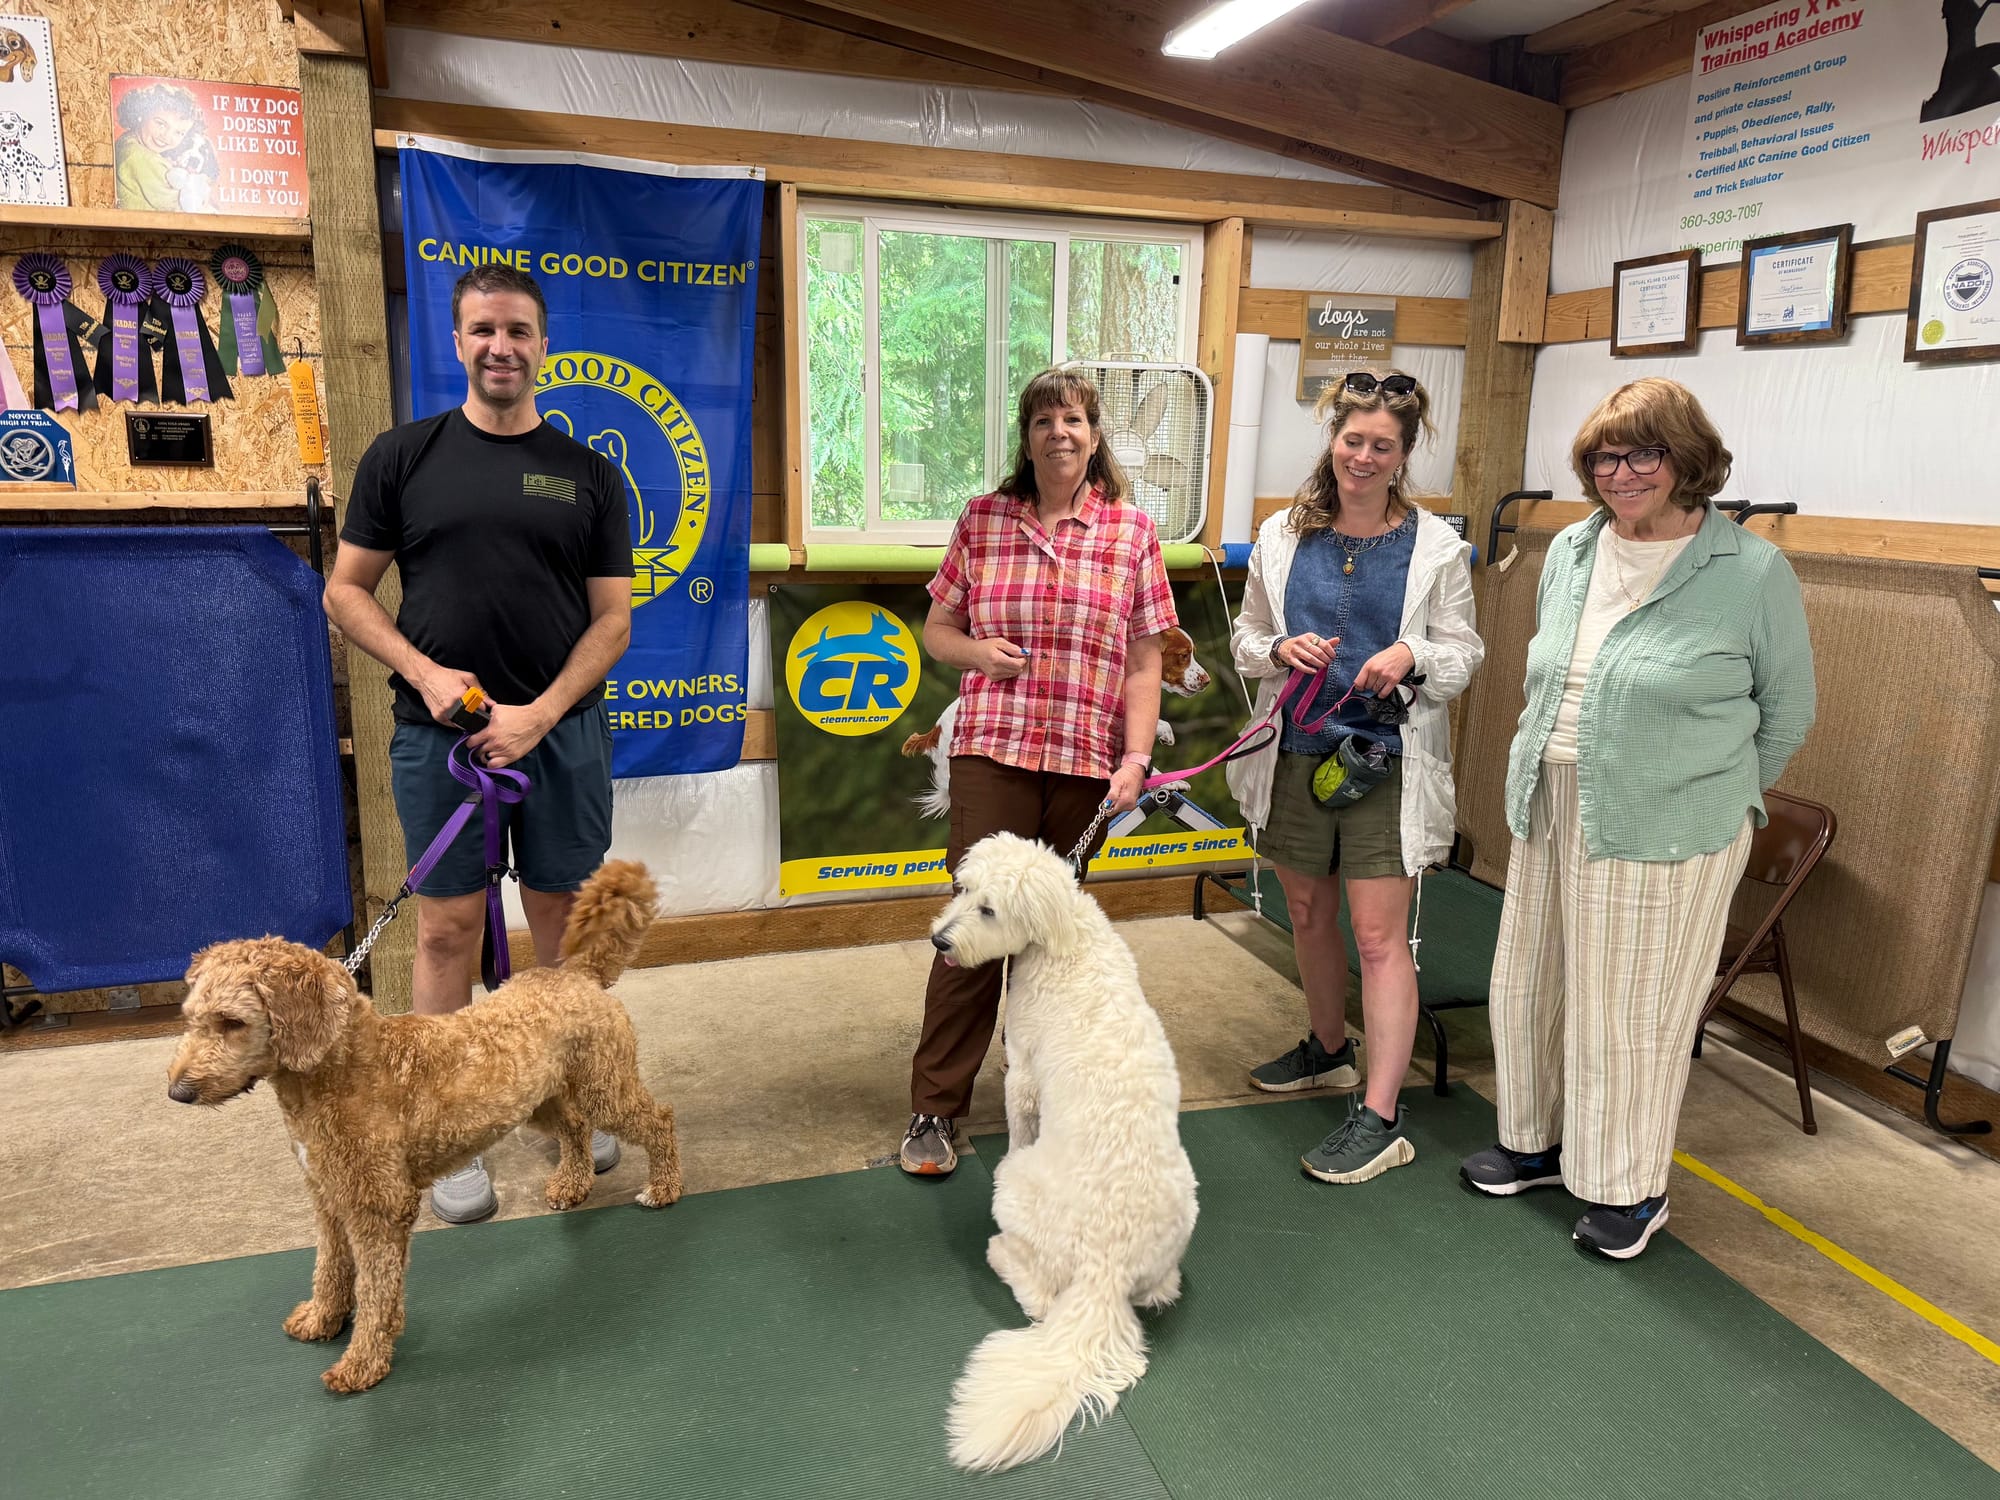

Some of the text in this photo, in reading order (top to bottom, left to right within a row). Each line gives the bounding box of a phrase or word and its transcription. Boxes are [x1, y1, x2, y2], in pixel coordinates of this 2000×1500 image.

[1700, 8, 1864, 73] Training Academy
[1704, 7, 1800, 51] Whispering
[1697, 55, 1848, 104] Positive Reinforcement Group
[212, 95, 299, 116] IF MY DOG
[1694, 90, 1792, 124] and private classes!
[222, 115, 292, 135] DOESN'T
[1703, 100, 1835, 141] Puppies, Obedience, Rally,
[217, 135, 301, 158] LIKE YOU,
[1699, 121, 1835, 161] Treibball, Behavioral Issues
[1695, 132, 1871, 179] Certified AKC Canine Good Citizen
[230, 167, 289, 186] I DON'T
[1693, 171, 1784, 199] and Trick Evaluator
[219, 187, 303, 206] LIKE YOU.
[1680, 202, 1763, 230] 360-393-7097
[418, 238, 531, 273] CANINE
[539, 253, 628, 279] GOOD
[1772, 256, 1814, 269] CERTIFICATE
[1318, 299, 1369, 339] dogs
[1353, 328, 1386, 337] are not
[1315, 341, 1385, 351] our whole lives
[1331, 353, 1369, 364] but they
[639, 383, 706, 515] CITIZEN
[626, 674, 744, 699] OWNERS,
[798, 660, 909, 712] CR
[680, 702, 747, 727] DOGS
[819, 714, 889, 724] cleanrun.com
[817, 863, 898, 880] Serving
[1108, 842, 1188, 858] handlers
[1192, 838, 1238, 851] since
